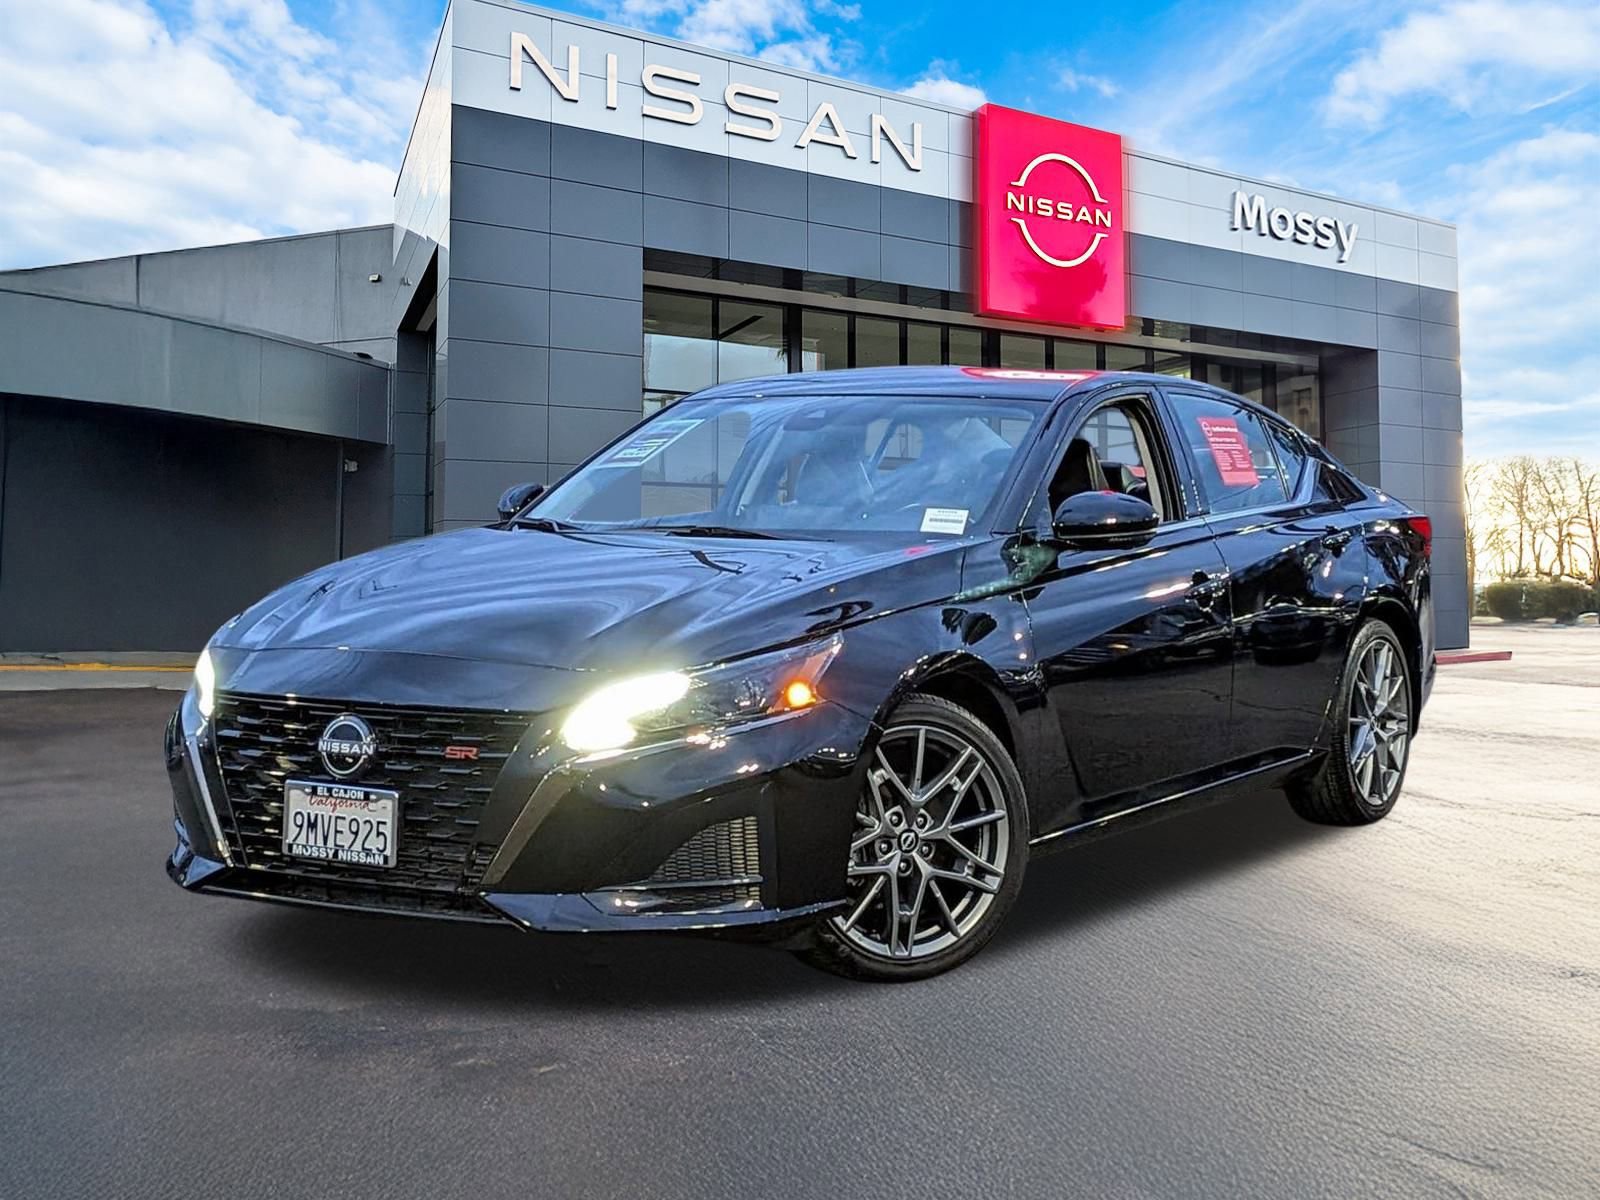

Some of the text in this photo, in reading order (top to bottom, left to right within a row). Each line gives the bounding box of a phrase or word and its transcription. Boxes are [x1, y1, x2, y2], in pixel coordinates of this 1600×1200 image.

[509, 31, 922, 171] NISSAN
[1007, 191, 1112, 228] NISSAN
[1231, 190, 1360, 263] Mossy
[318, 740, 375, 755] NISSAN
[445, 746, 479, 760] SR
[309, 794, 377, 813] California
[317, 786, 364, 800] EL CAJON
[292, 811, 388, 853] 9MVE925
[292, 843, 384, 865] MOSSY NISSAN
